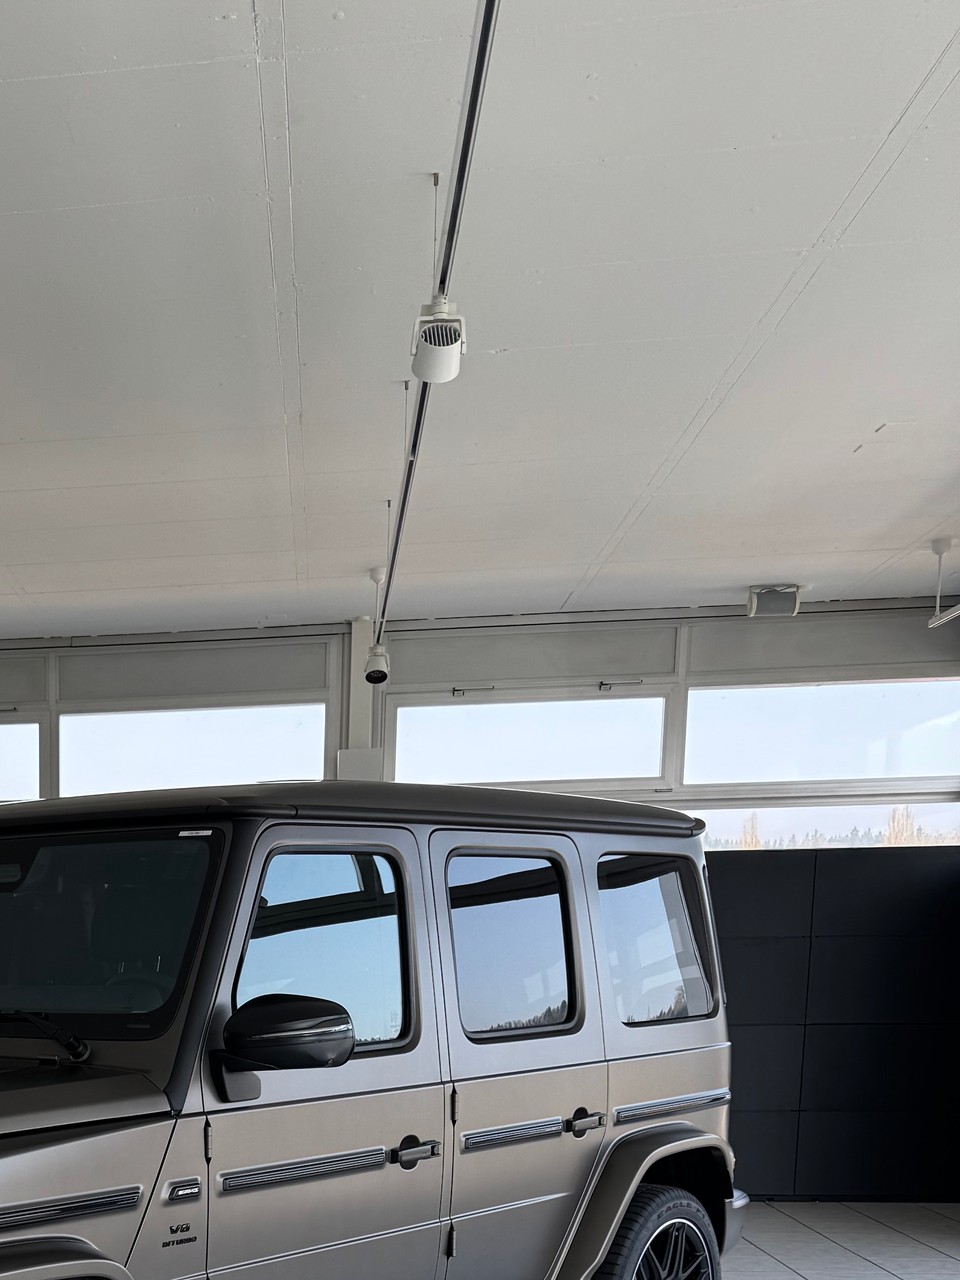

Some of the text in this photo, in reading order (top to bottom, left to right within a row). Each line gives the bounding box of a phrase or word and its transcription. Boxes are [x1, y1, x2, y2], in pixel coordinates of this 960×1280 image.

[657, 1202, 693, 1220] EAGLE
[169, 1223, 191, 1235] V8
[162, 1236, 198, 1248] BITURBO
